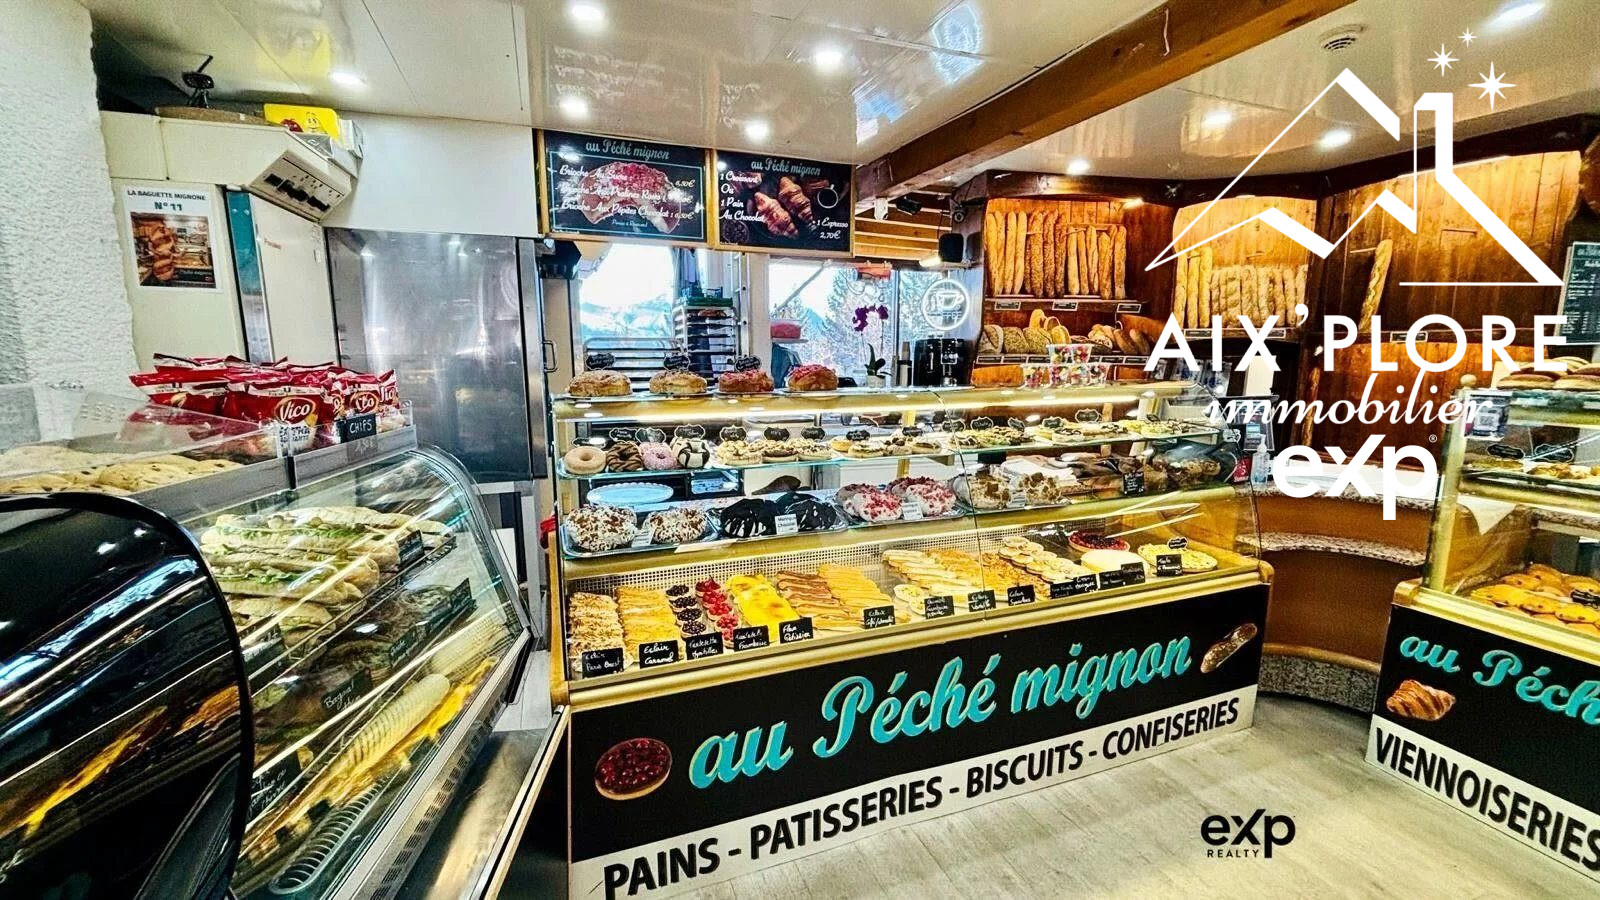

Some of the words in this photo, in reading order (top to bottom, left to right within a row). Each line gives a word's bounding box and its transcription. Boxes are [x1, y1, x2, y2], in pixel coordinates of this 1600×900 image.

[585, 142, 601, 152] au
[602, 139, 633, 155] Péché
[633, 146, 670, 161] mignon
[560, 165, 589, 177] Brioche
[751, 161, 763, 171] au
[764, 158, 791, 172] Péché
[791, 164, 821, 177] mignon
[725, 170, 759, 184] Croissant
[137, 190, 173, 199] BAGUETTE
[174, 193, 206, 201] MIGNONE
[721, 183, 734, 194] Ou
[170, 203, 183, 211] 11
[562, 200, 591, 211] Brioche
[726, 197, 744, 208] Pain
[718, 209, 733, 220] Au
[733, 210, 766, 223] Chocolat
[821, 217, 849, 229] Expresso
[820, 230, 841, 240] 2,70€
[280, 400, 311, 423] Vico
[349, 418, 373, 434] CHIPS
[644, 652, 675, 665] Caramel
[1400, 636, 1461, 673] au
[689, 720, 794, 790] au
[812, 654, 1002, 758] Péché
[1010, 634, 1192, 720] mignon
[603, 837, 720, 900] PAINS
[750, 775, 943, 861] PATISSERIES
[965, 739, 1085, 799] BISCUITS
[1102, 697, 1240, 761] CONFISERIES
[1376, 728, 1600, 872] VIENNOISERIES
